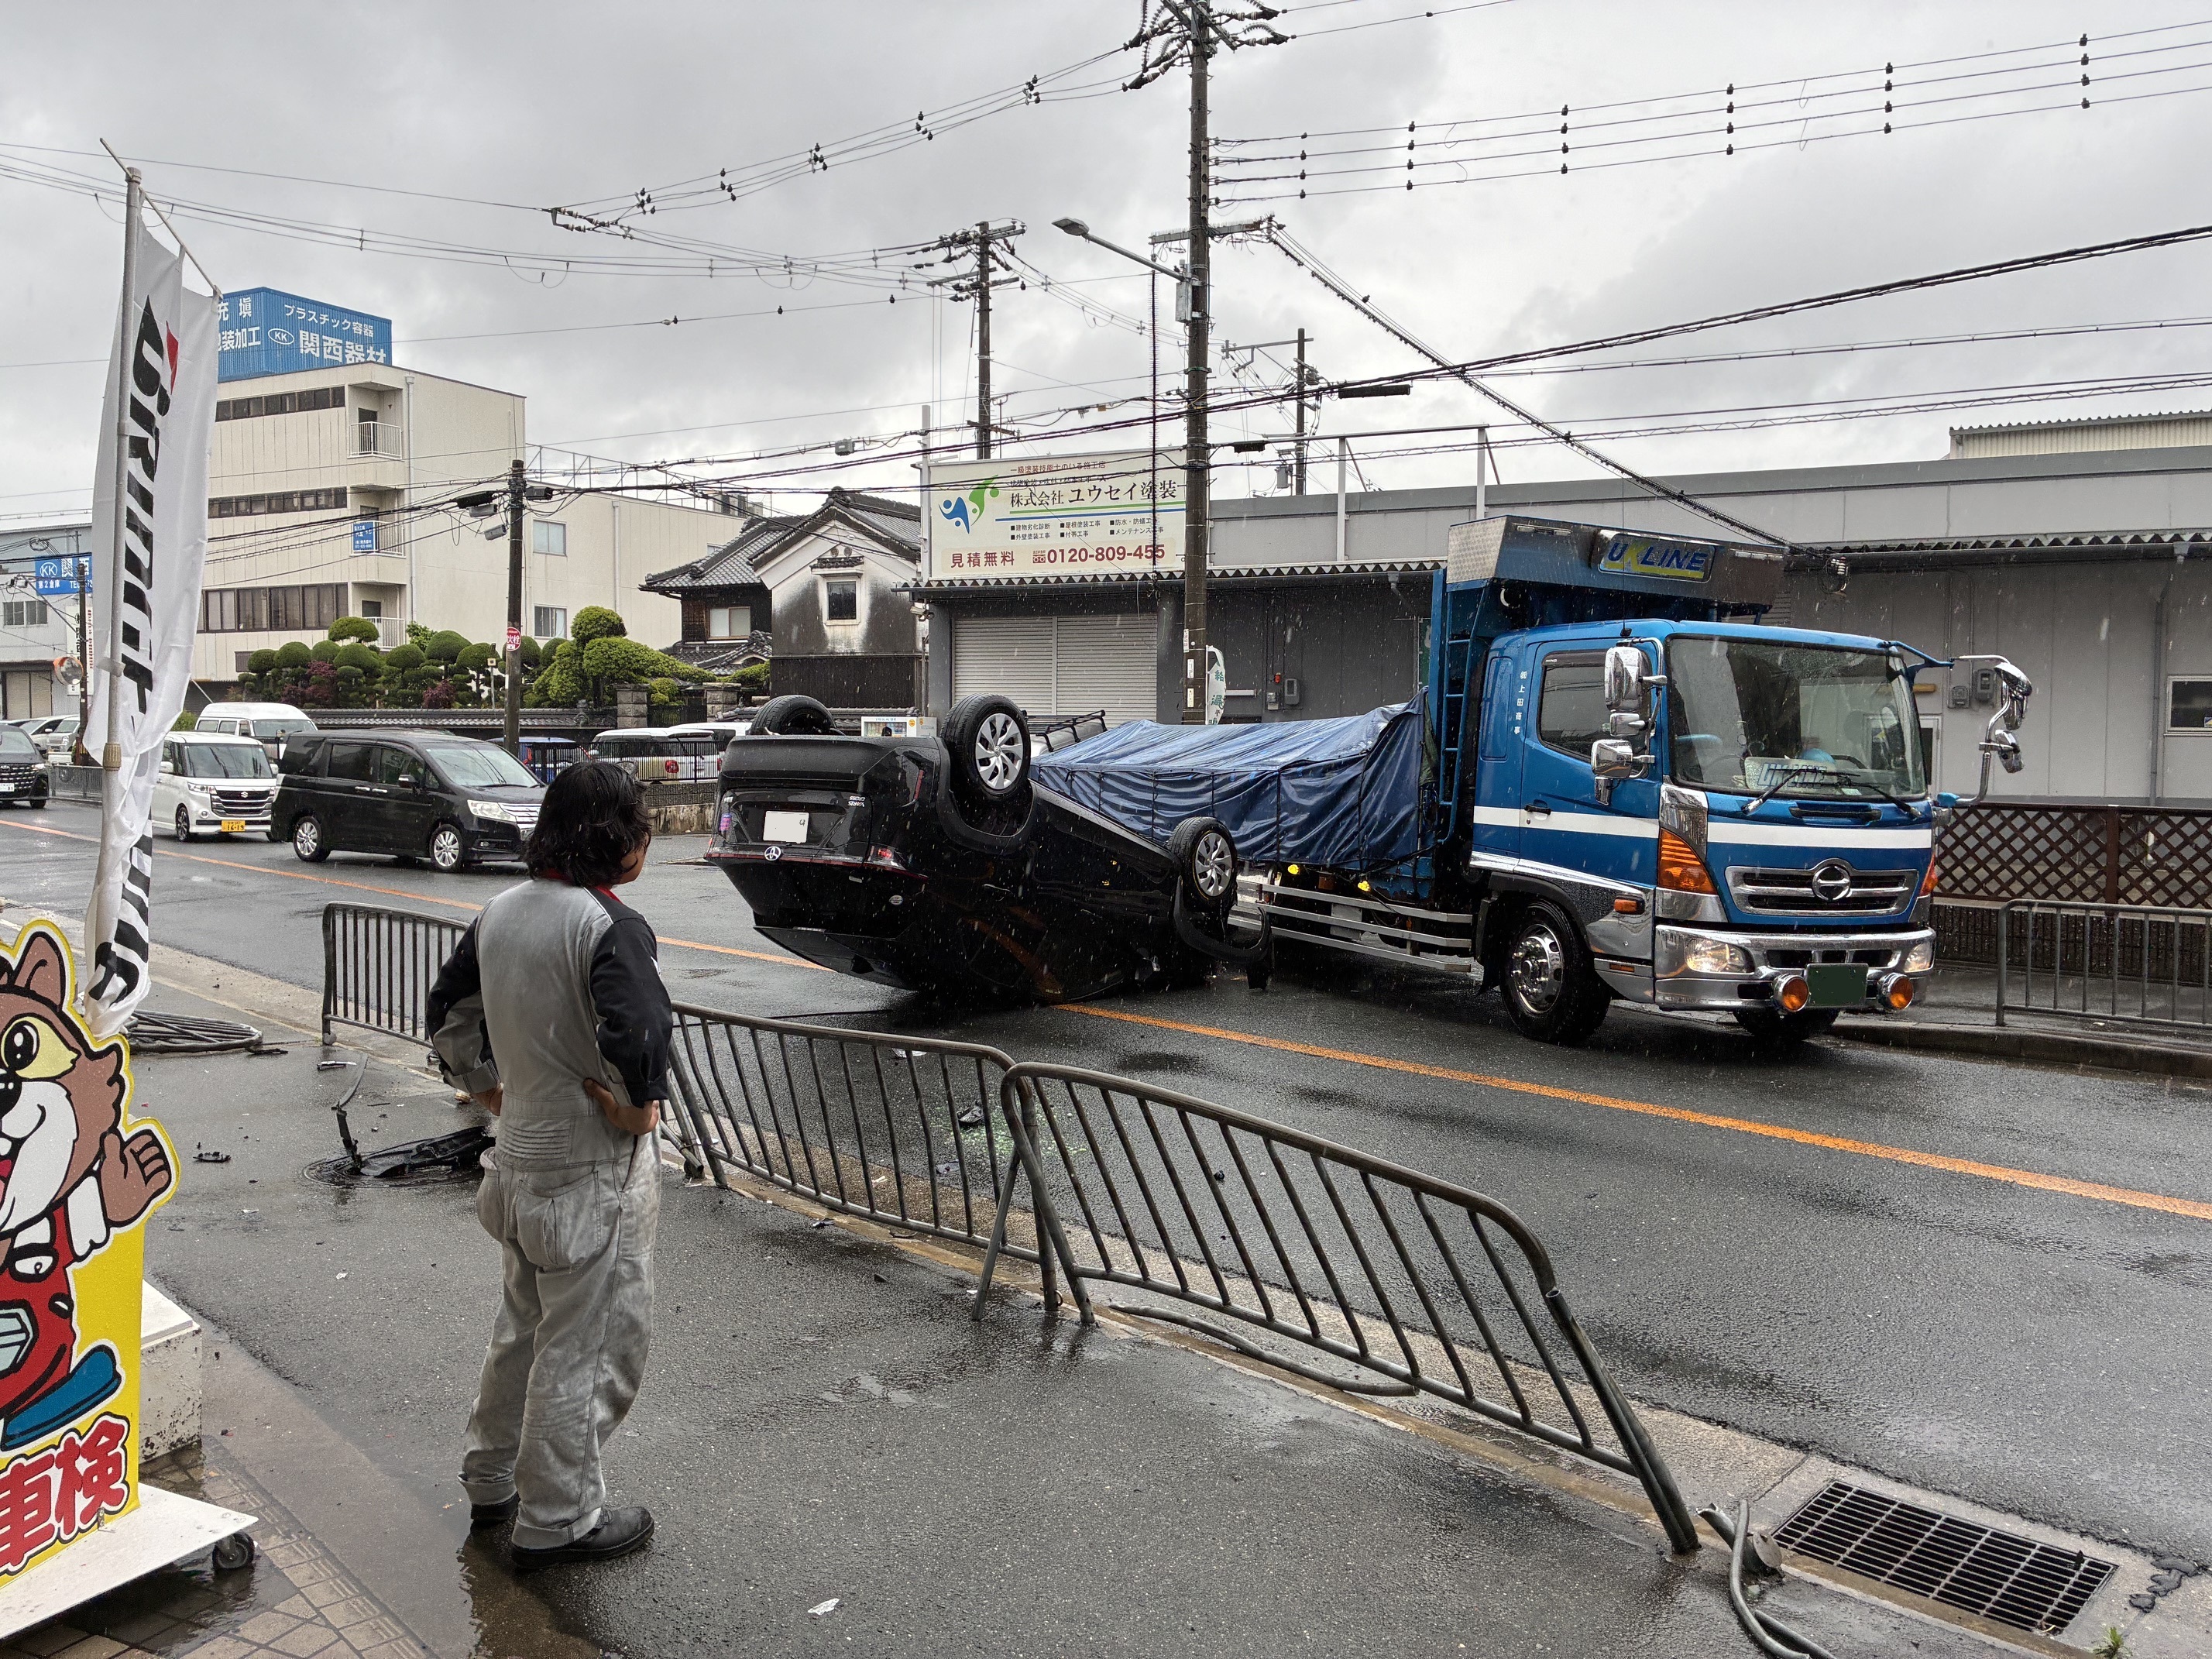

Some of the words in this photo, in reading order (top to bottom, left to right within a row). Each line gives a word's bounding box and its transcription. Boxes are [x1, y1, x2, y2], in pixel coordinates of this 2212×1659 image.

[284, 304, 374, 338] プラスチック容器
[273, 331, 288, 342] KK
[1115, 517, 1154, 526] 防水・防蟻工
[950, 550, 1015, 568] 見積無料
[1046, 544, 1166, 564] 0120-809-455
[41, 565, 57, 576] KK
[507, 634, 520, 644] 火栓
[0, 1419, 126, 1568] 車検
